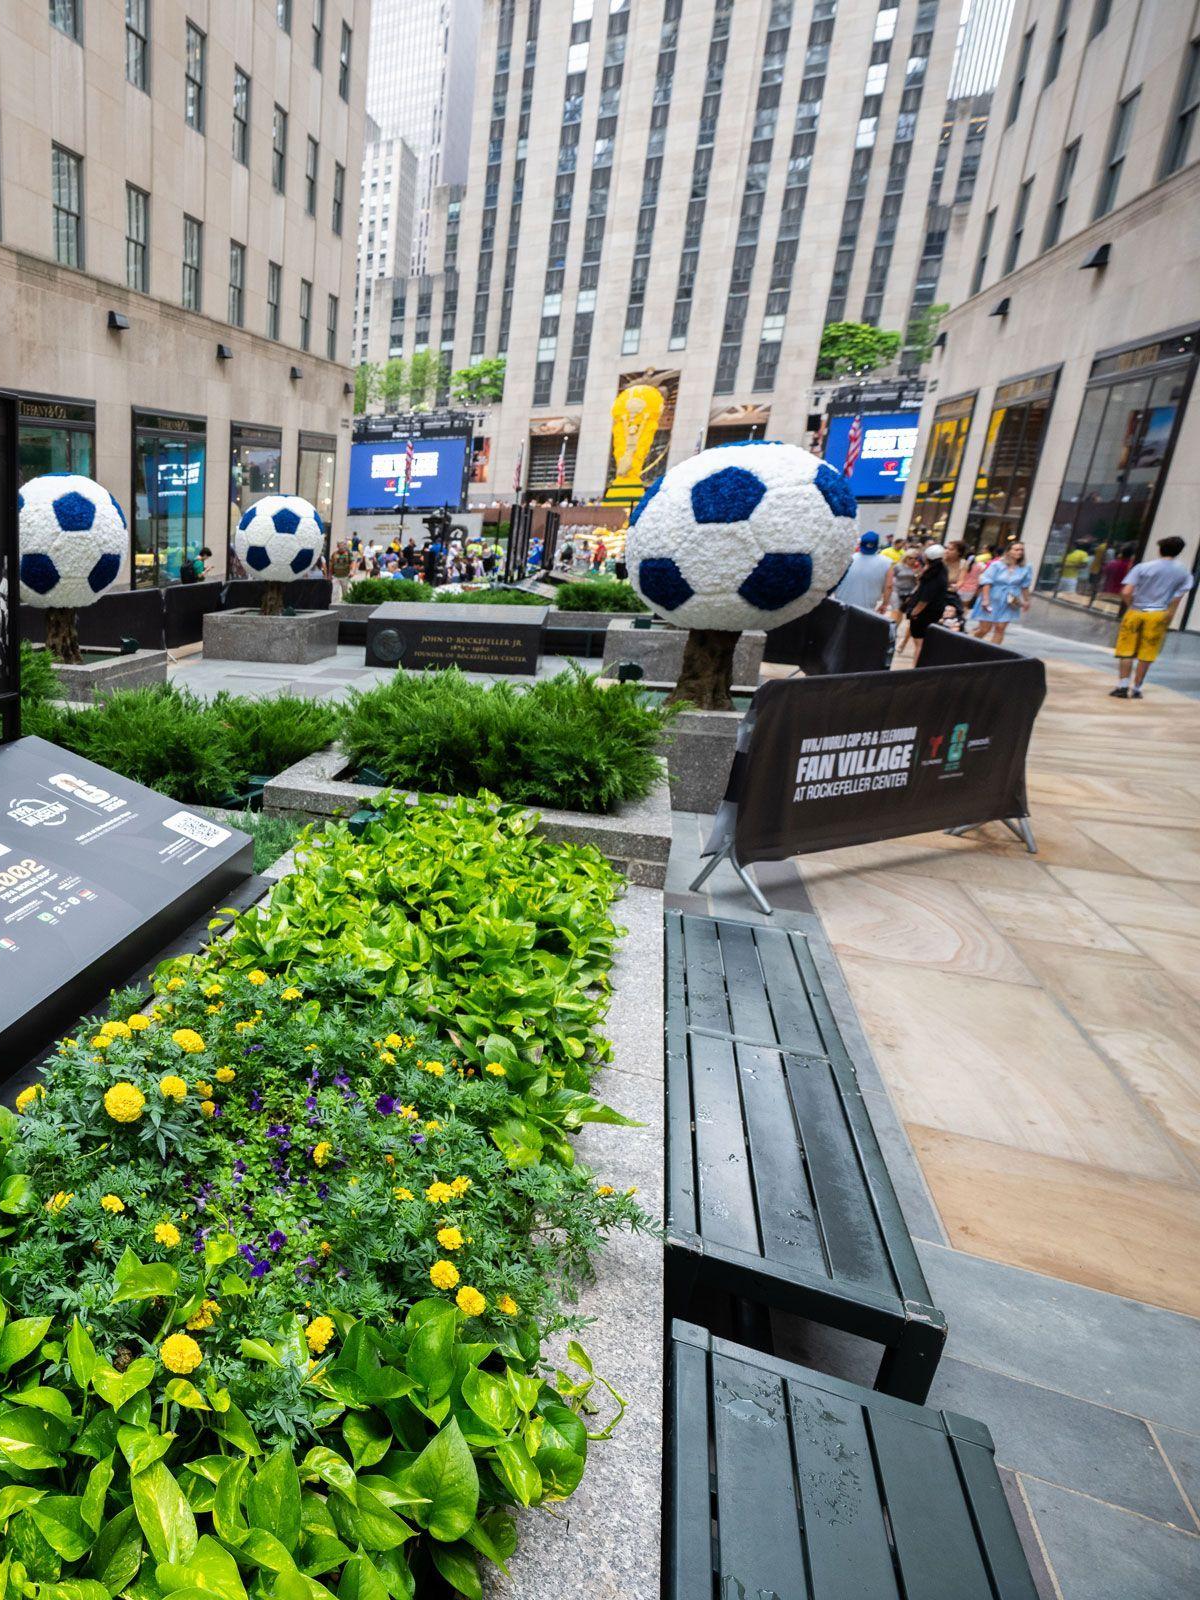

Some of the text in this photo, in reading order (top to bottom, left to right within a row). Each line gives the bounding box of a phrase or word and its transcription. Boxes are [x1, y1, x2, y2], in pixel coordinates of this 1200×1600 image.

[421, 635, 443, 643] JOHN
[456, 637, 510, 646] ROCKEFELLER
[821, 734, 847, 751] WORLD
[847, 732, 861, 748] CUP
[860, 731, 872, 746] 26
[795, 744, 914, 783] FAN VILLAGE
[793, 772, 909, 802] AT ROCKEFELLER CENTER
[7, 805, 35, 819] FIFA
[21, 804, 69, 827] MUSEUM
